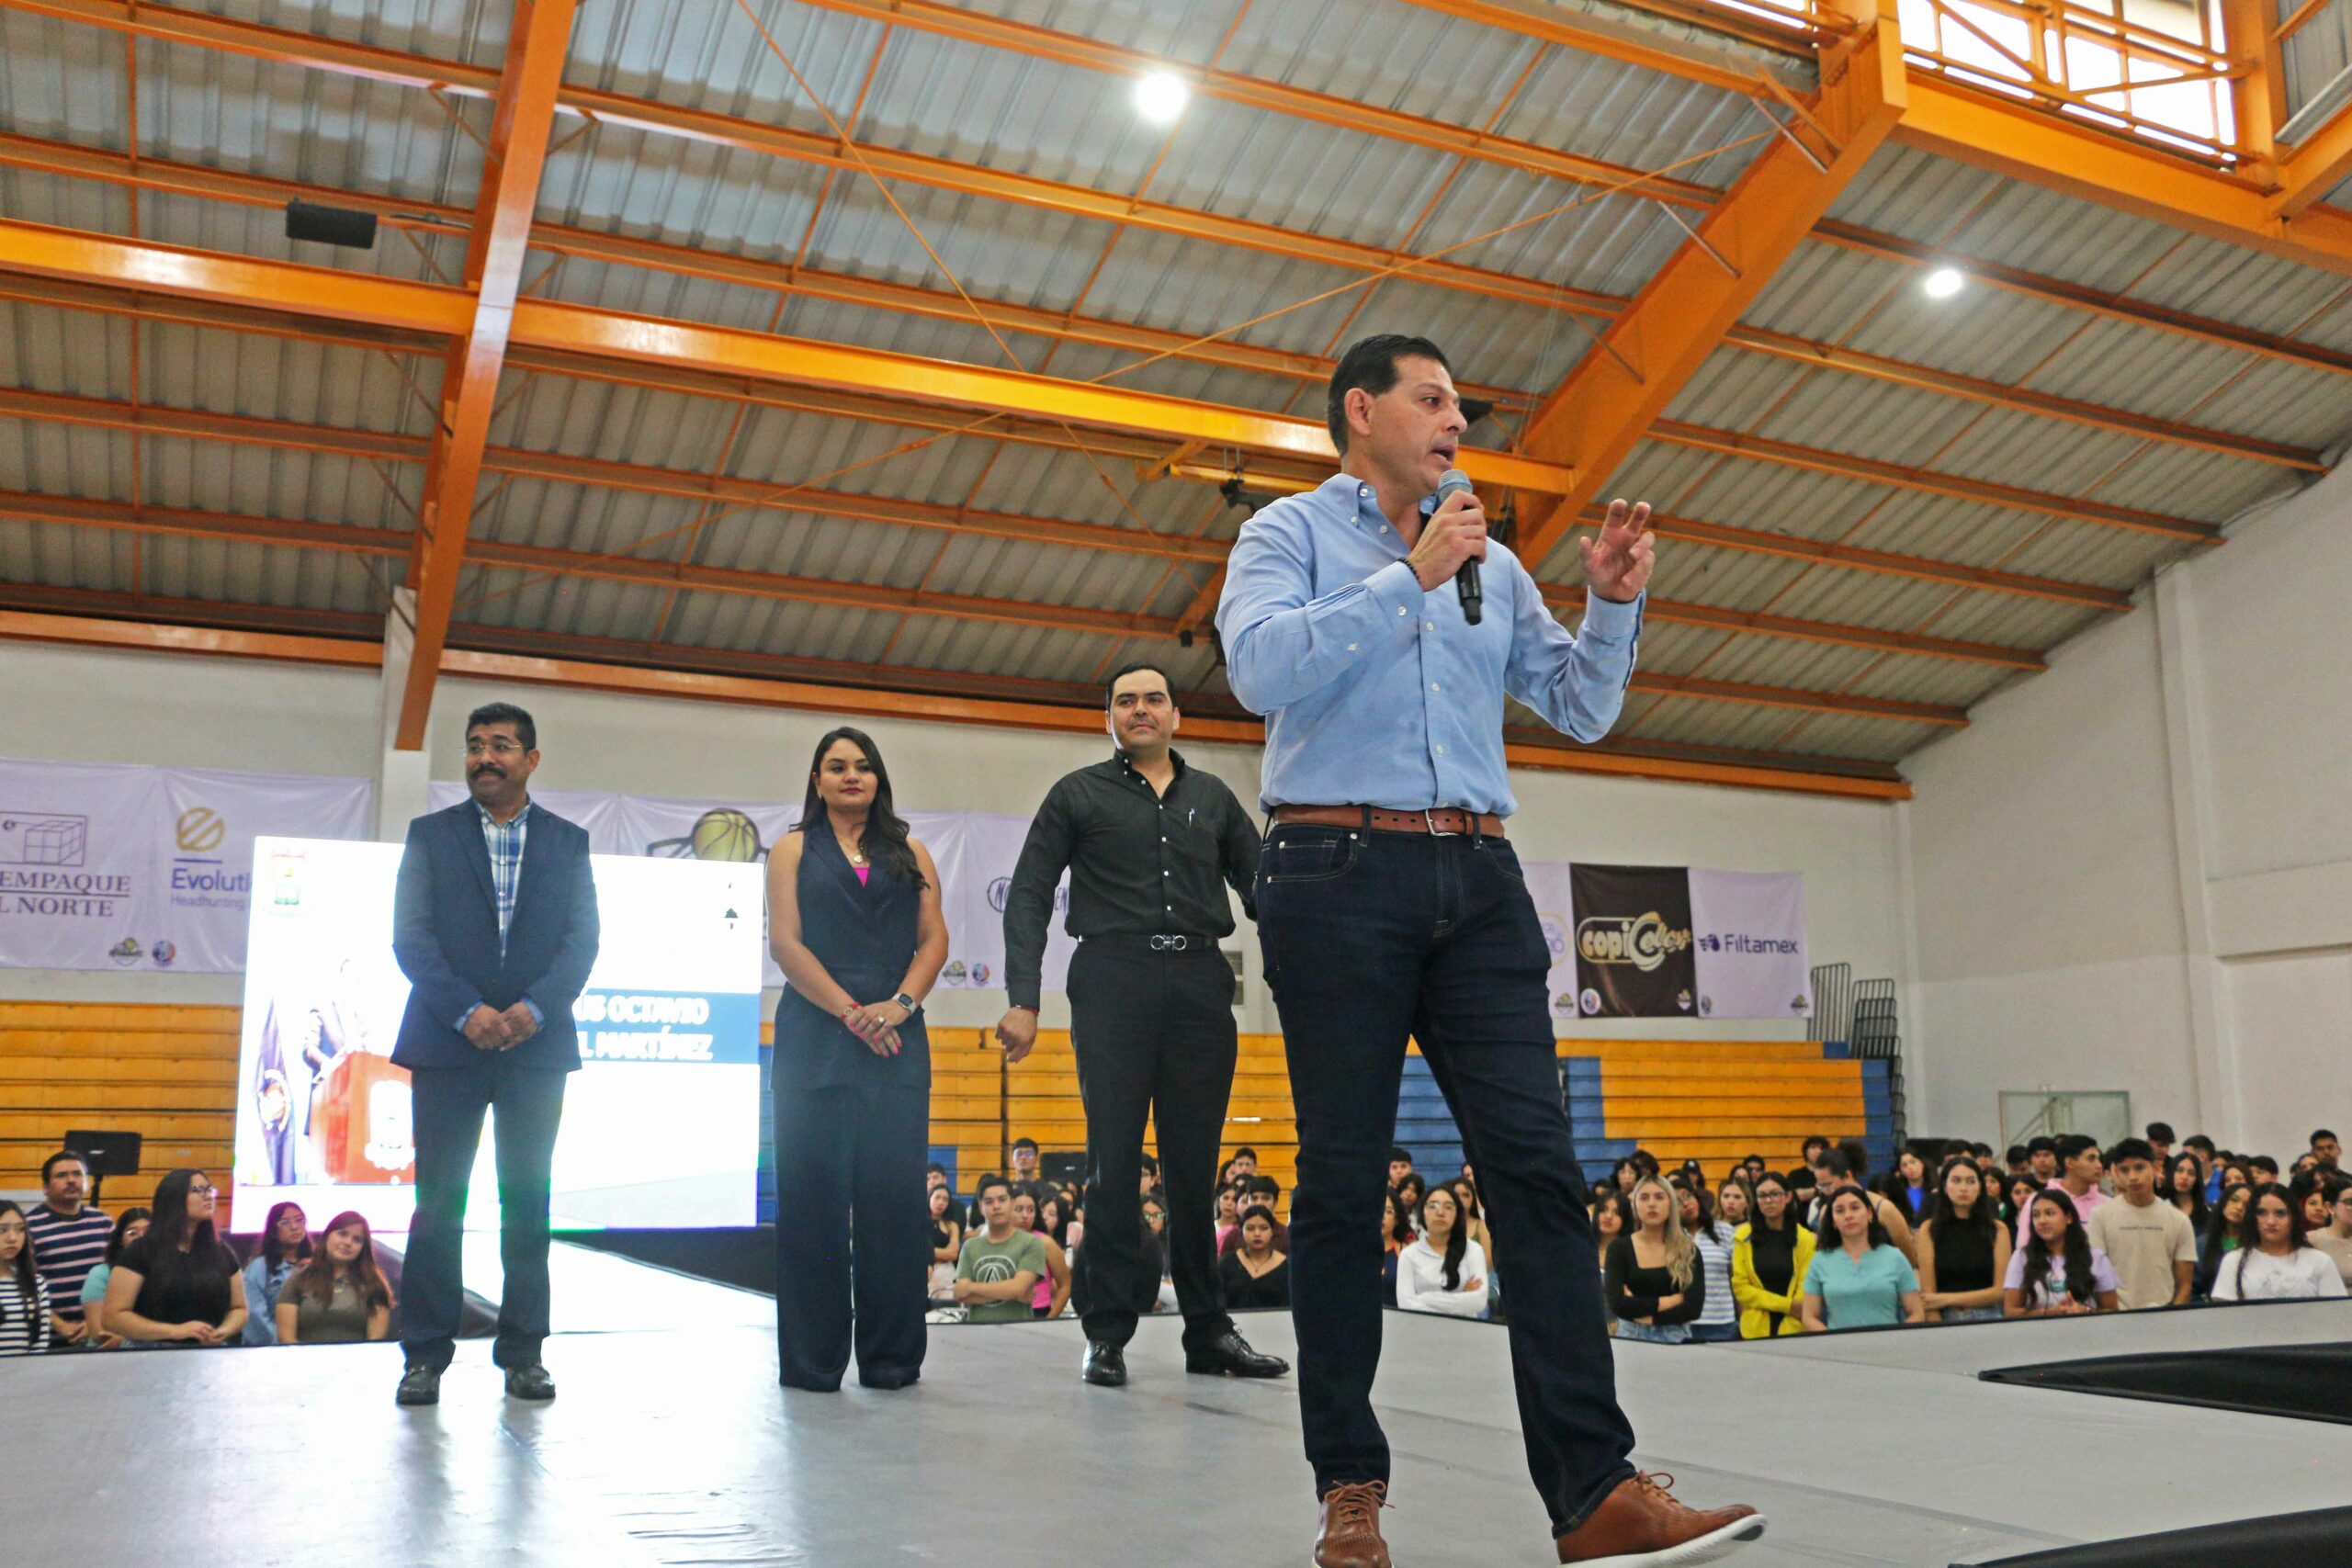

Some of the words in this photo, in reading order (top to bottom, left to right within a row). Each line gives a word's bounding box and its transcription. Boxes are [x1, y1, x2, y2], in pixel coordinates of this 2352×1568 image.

[0, 871, 130, 895] EMPAQUE
[17, 897, 115, 917] NORTE
[1724, 933, 1798, 953] Filtamex
